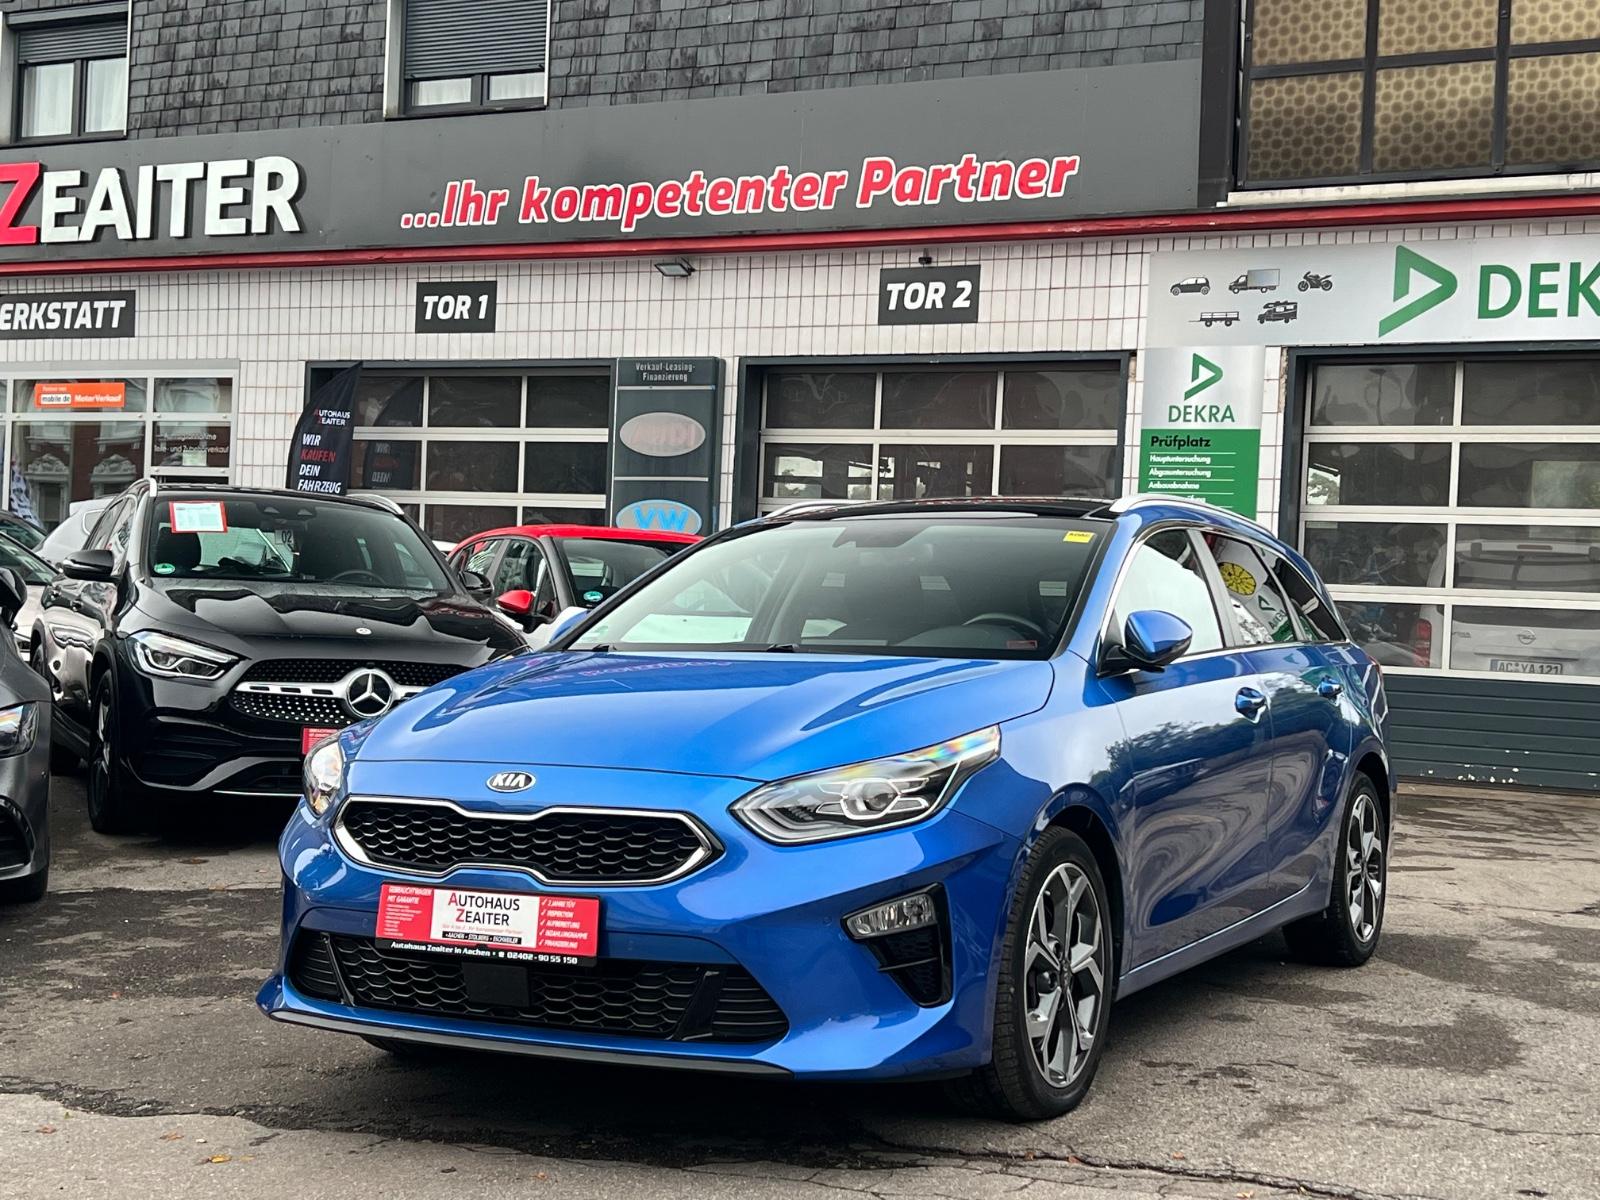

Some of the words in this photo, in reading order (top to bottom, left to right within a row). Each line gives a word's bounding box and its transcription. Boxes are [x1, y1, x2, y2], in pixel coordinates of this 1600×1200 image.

[401, 180, 510, 229] ...Ihr
[518, 165, 848, 232] kompetenter
[855, 153, 1081, 210] Partner
[0, 156, 301, 245] ZEAITER
[886, 282, 947, 310] TOR
[952, 280, 973, 308] 2
[423, 296, 470, 320] TOR
[478, 294, 489, 319] 1
[642, 372, 688, 383] Finanzierung
[1168, 405, 1236, 423] DEKRA
[302, 433, 321, 446] WIR
[1150, 435, 1212, 450] Prüfplatz
[300, 449, 336, 462] KAUFEN
[299, 464, 320, 477] DEIN
[297, 479, 341, 494] FAHRZEUG
[633, 506, 689, 531] VW
[1538, 665, 1560, 675] 121
[492, 773, 526, 788] KIA
[448, 892, 521, 911] AUTOHAUS
[455, 908, 510, 926] ZEAITER
[390, 941, 425, 950] Autohaus
[426, 944, 452, 953] Zeaiter
[462, 948, 490, 956] Aachen
